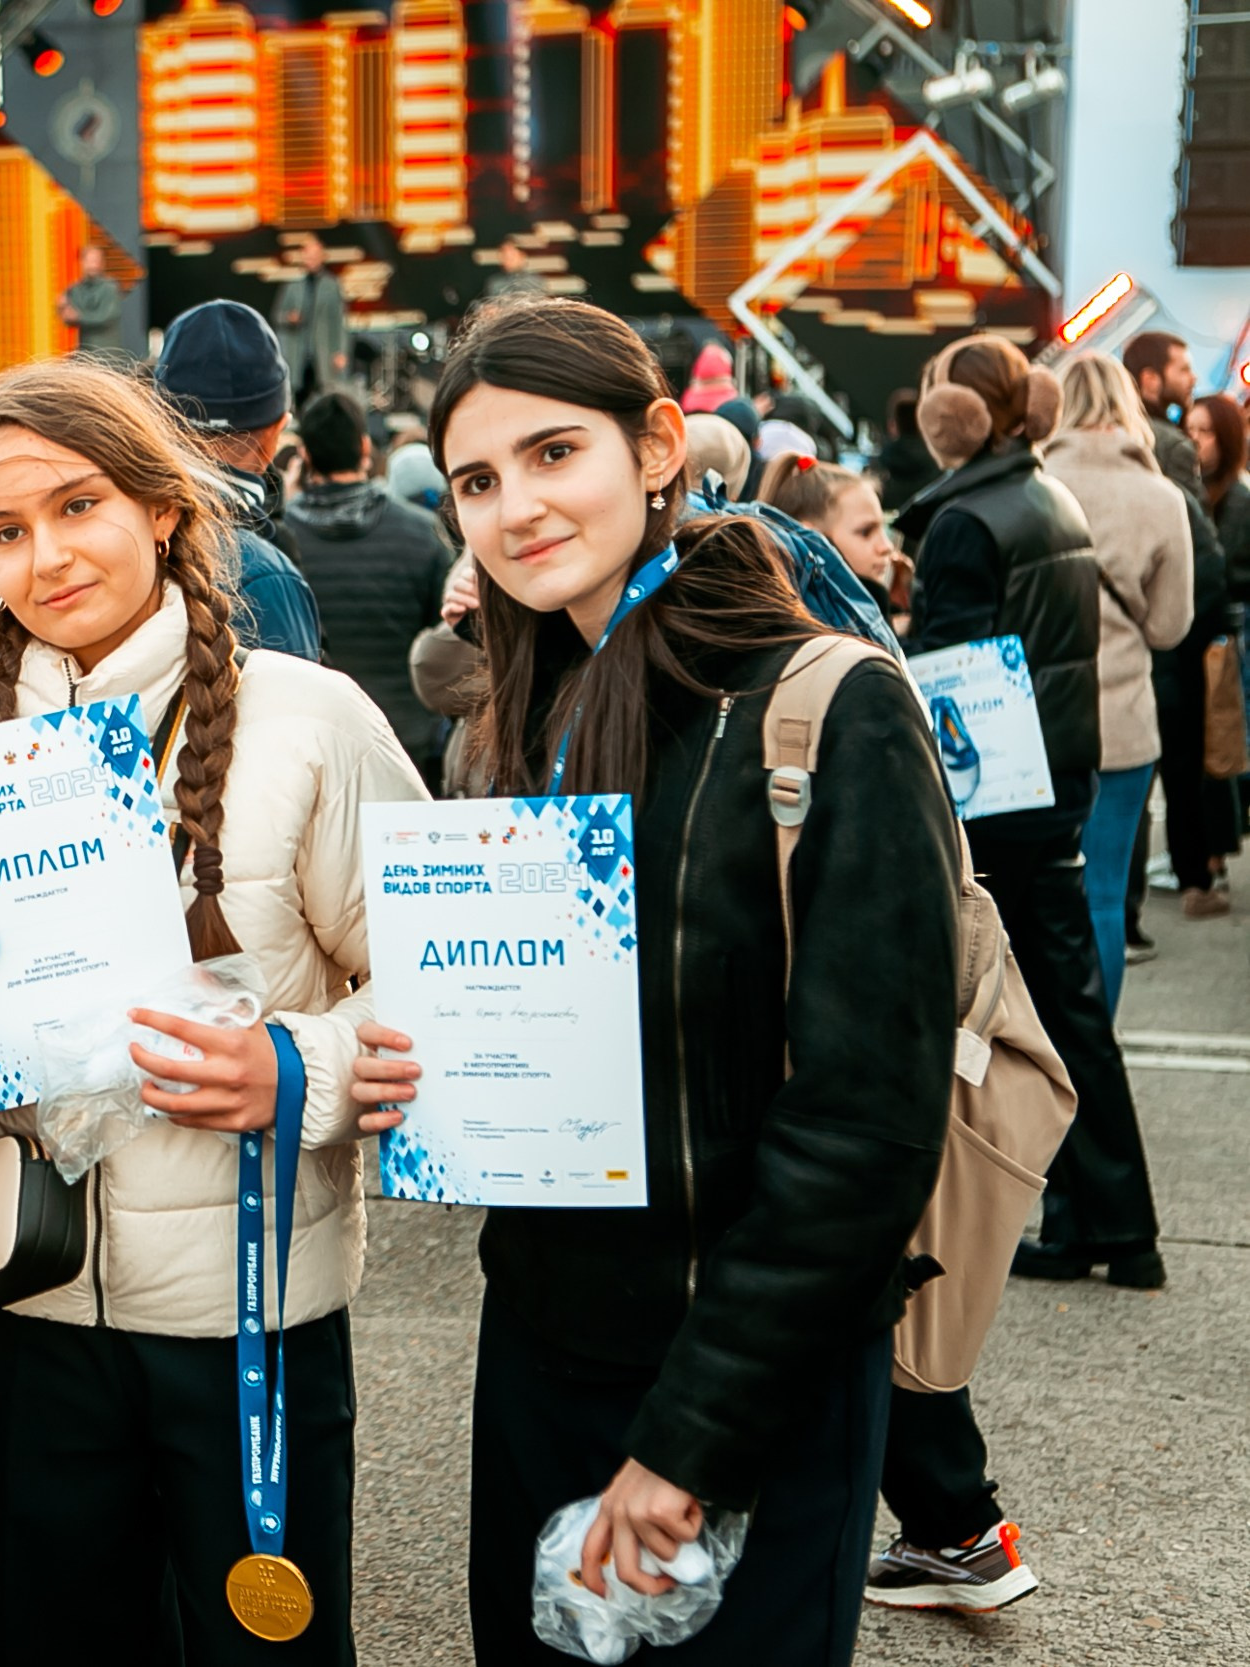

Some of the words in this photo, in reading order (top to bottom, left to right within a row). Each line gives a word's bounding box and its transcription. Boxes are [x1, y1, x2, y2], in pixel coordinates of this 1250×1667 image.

[108, 726, 132, 745] 10
[112, 743, 134, 756] ЛЕТ
[28, 763, 117, 807] 2024
[590, 828, 615, 845] 10
[591, 846, 615, 856] ЛЕТ
[382, 864, 418, 878] ДЕНЬ
[422, 864, 485, 877] ЗИМНИХ
[499, 862, 590, 894] 2024
[383, 881, 431, 896] ВИДОВ
[436, 881, 492, 894] СПОРТА
[420, 939, 565, 971] ДИПЛОМ
[247, 1241, 258, 1312] ГАЗПРОМБАНК
[249, 1415, 263, 1485] ГАЗПРОМБАНК
